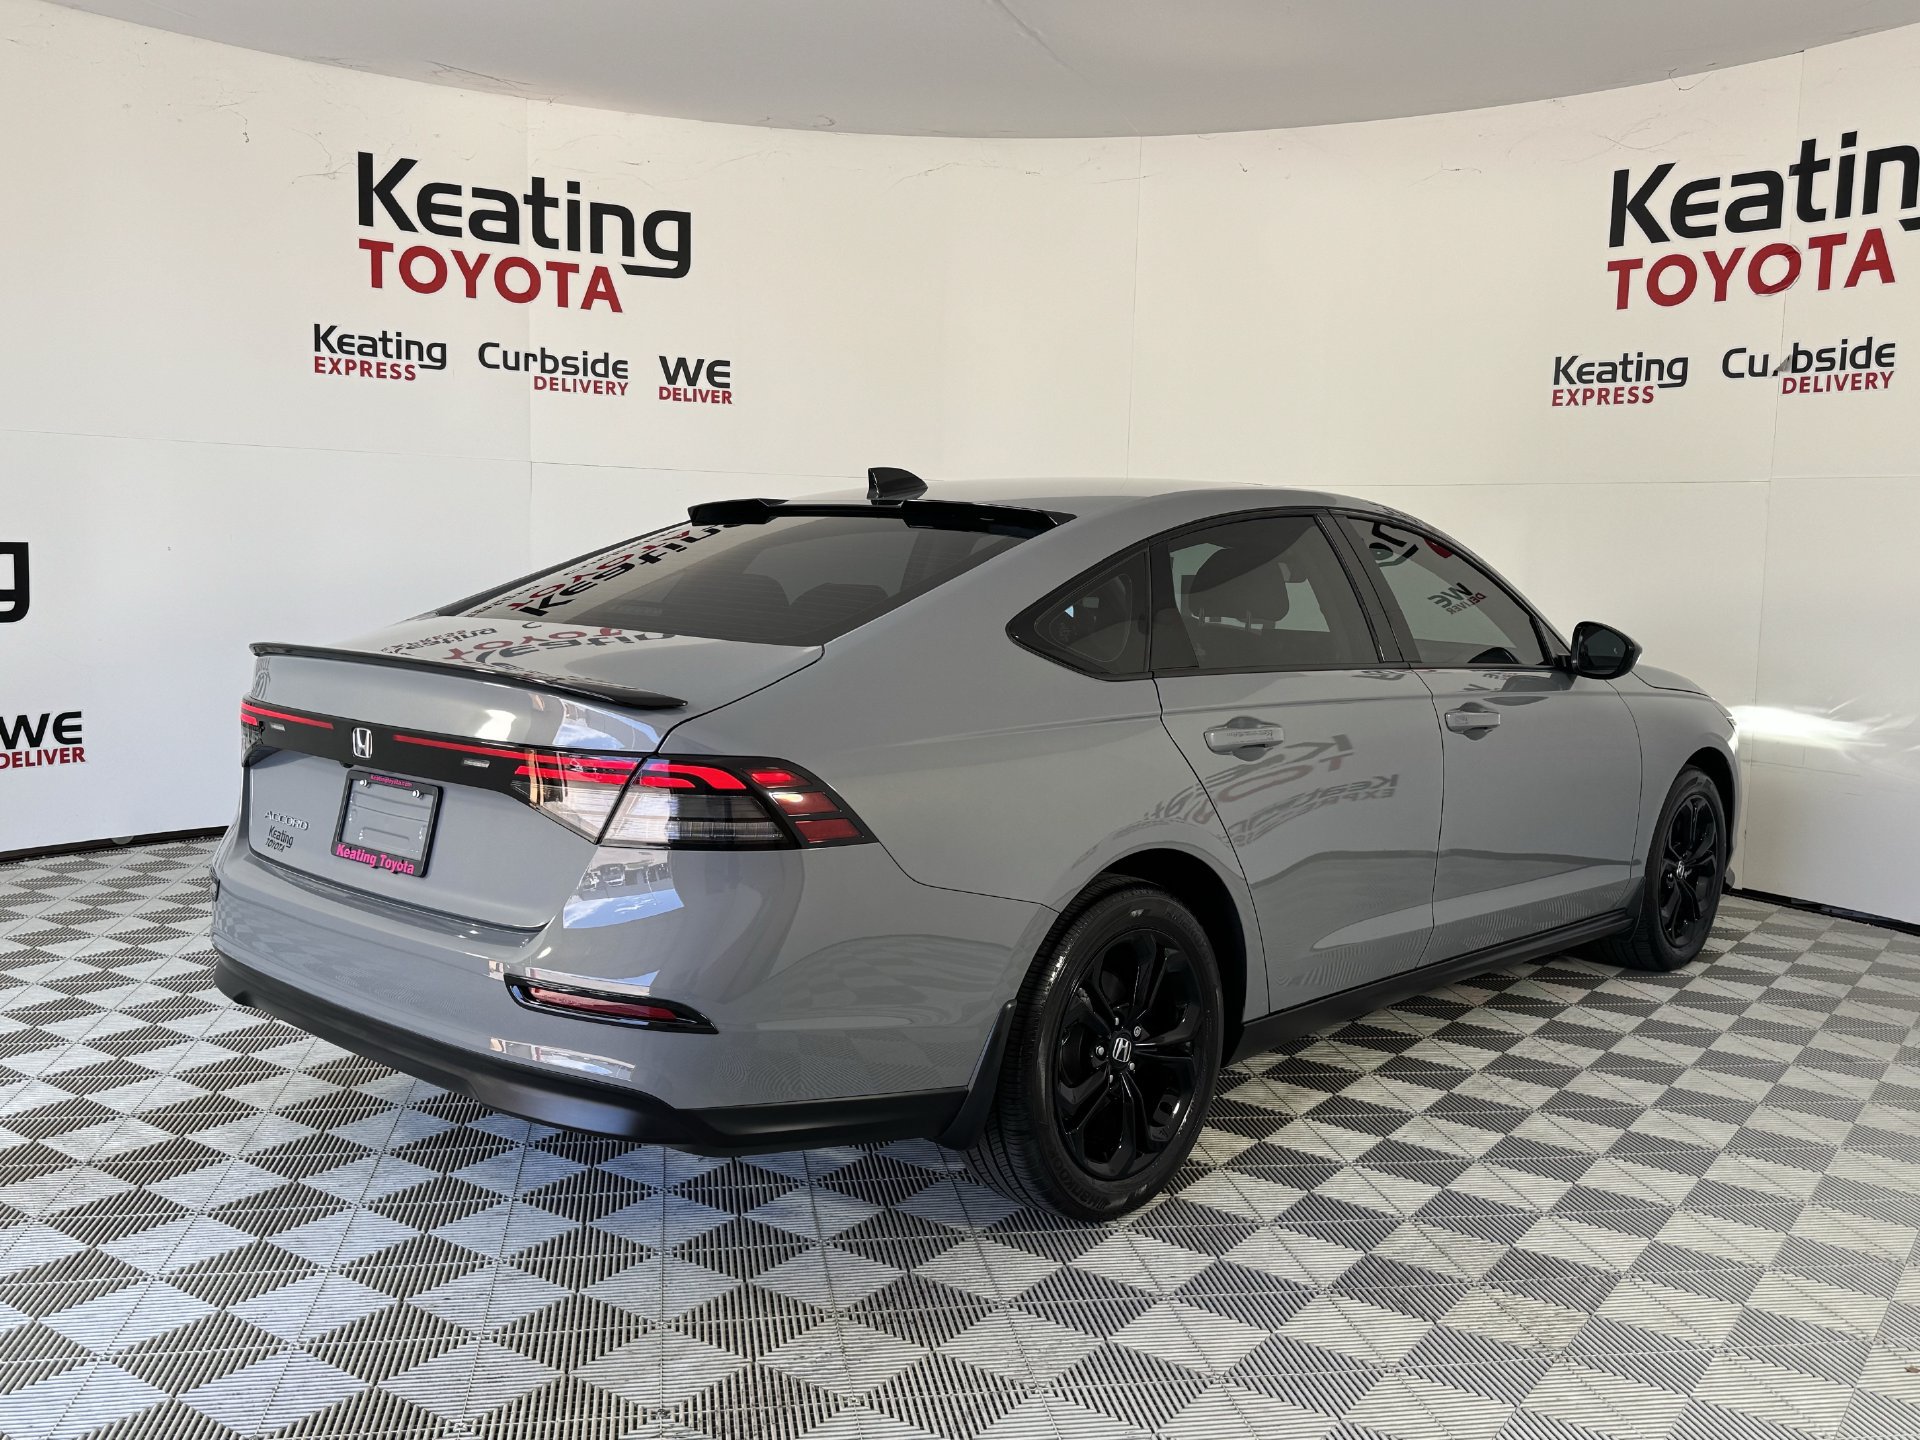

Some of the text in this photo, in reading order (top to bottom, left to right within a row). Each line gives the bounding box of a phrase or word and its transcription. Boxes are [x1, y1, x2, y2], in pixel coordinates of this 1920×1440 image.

[1609, 131, 1920, 247] Keatin
[358, 151, 691, 278] Keating
[359, 239, 623, 313] TOYOTA
[1607, 228, 1896, 310] TOYOTA
[314, 323, 447, 370] Keating
[478, 342, 628, 379] Curbside
[314, 356, 417, 381] EXPRESS
[658, 355, 731, 388] WE
[1553, 352, 1688, 389] Keating
[1782, 371, 1895, 395] DELIVERY
[533, 376, 628, 396] DELIVERY
[658, 386, 733, 404] DELIVER
[1551, 386, 1655, 407] EXPRESS
[0, 747, 86, 769] DELIVER
[264, 837, 285, 853] TOYOTA
[268, 825, 294, 849] Keating
[336, 844, 415, 875] Keating Toyota
